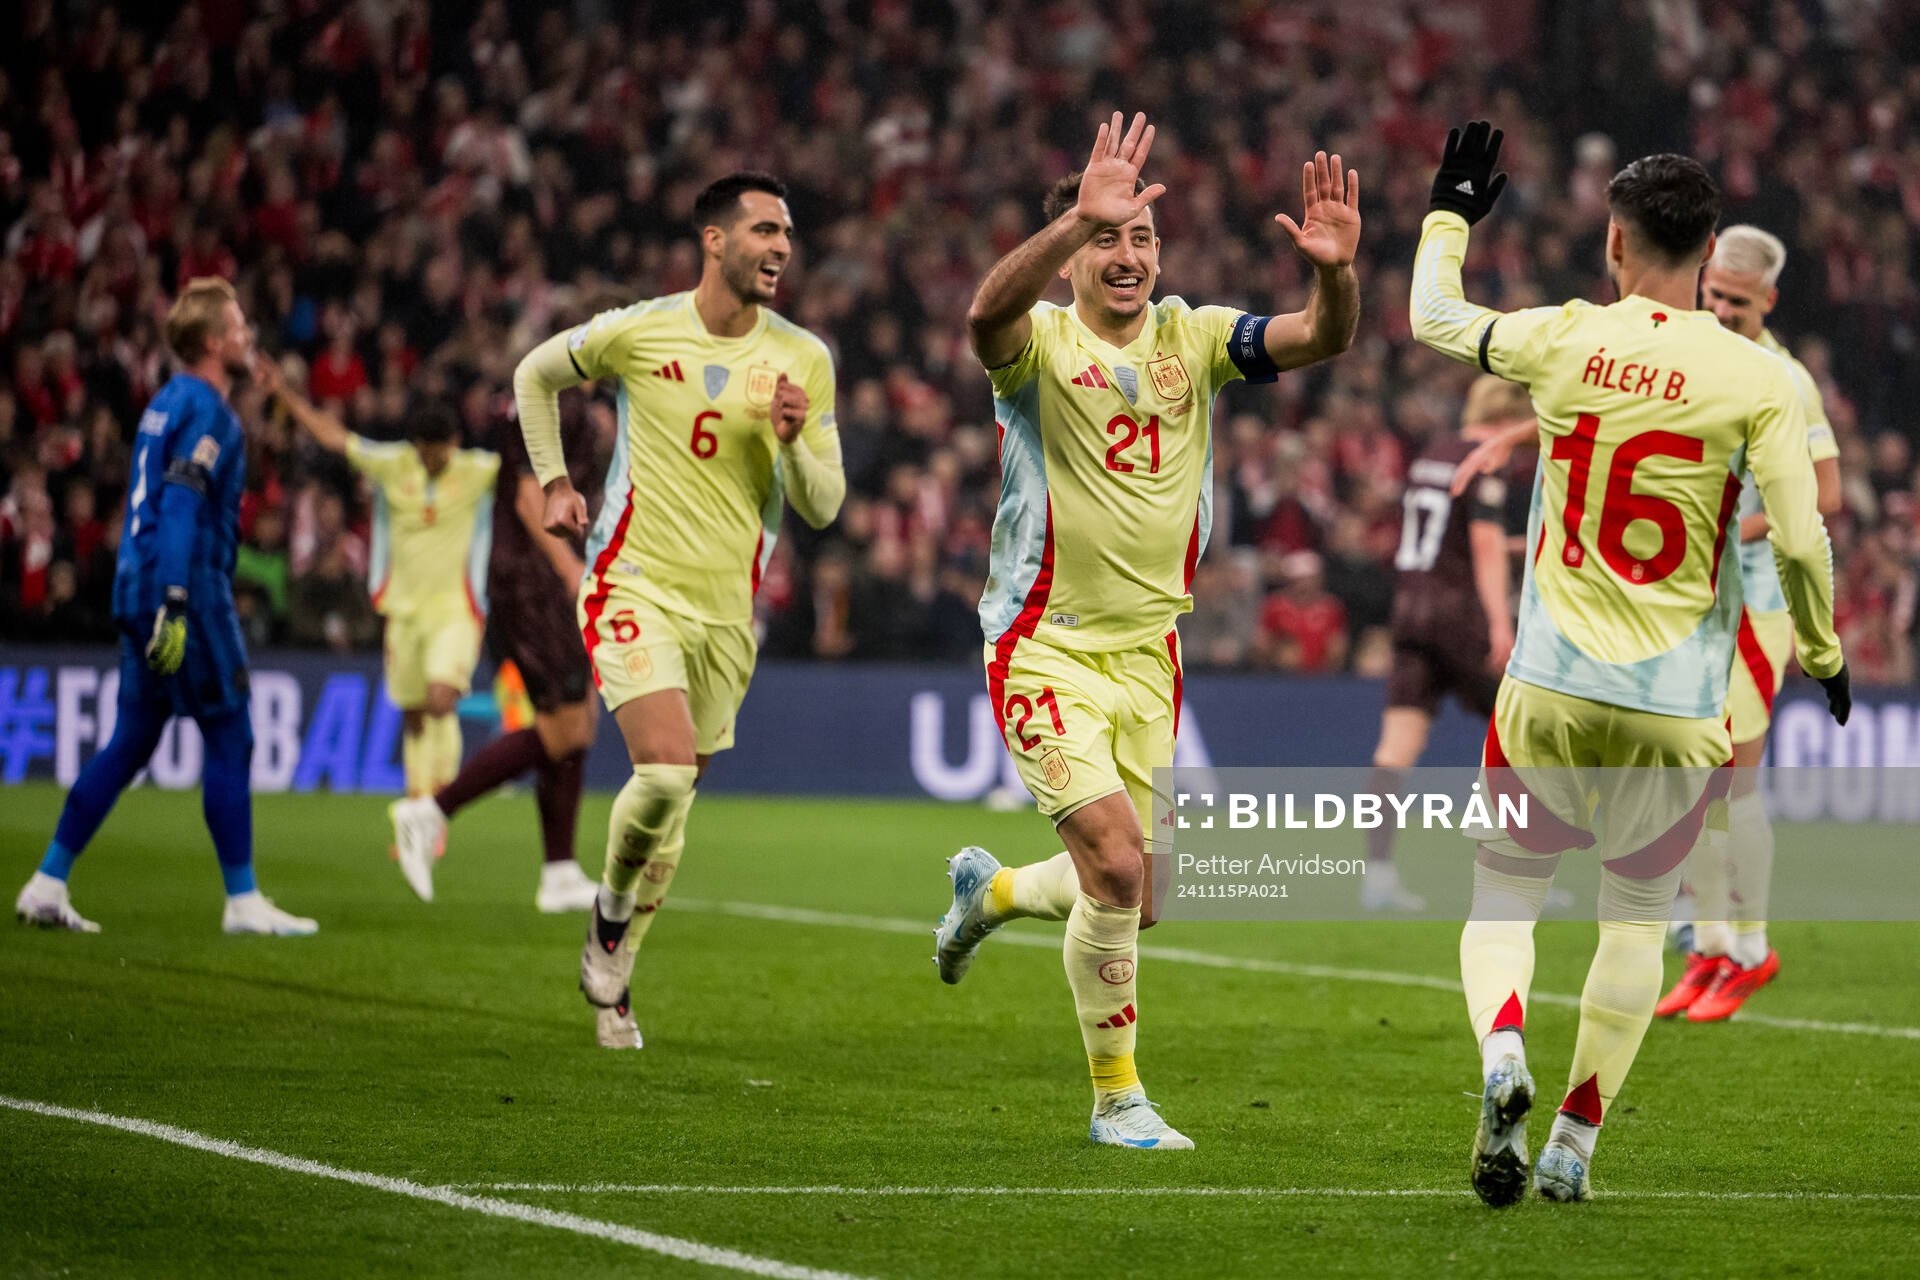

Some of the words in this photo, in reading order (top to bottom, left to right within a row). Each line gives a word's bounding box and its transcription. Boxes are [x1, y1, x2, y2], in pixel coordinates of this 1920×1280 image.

[1581, 347, 1659, 397] ÁLEX
[1662, 370, 1689, 405] B.
[690, 410, 723, 460] 6
[1105, 413, 1160, 474] 21
[1396, 488, 1450, 571] 17
[1551, 412, 1704, 586] 16
[609, 609, 641, 644] 6
[1005, 686, 1067, 752] 21
